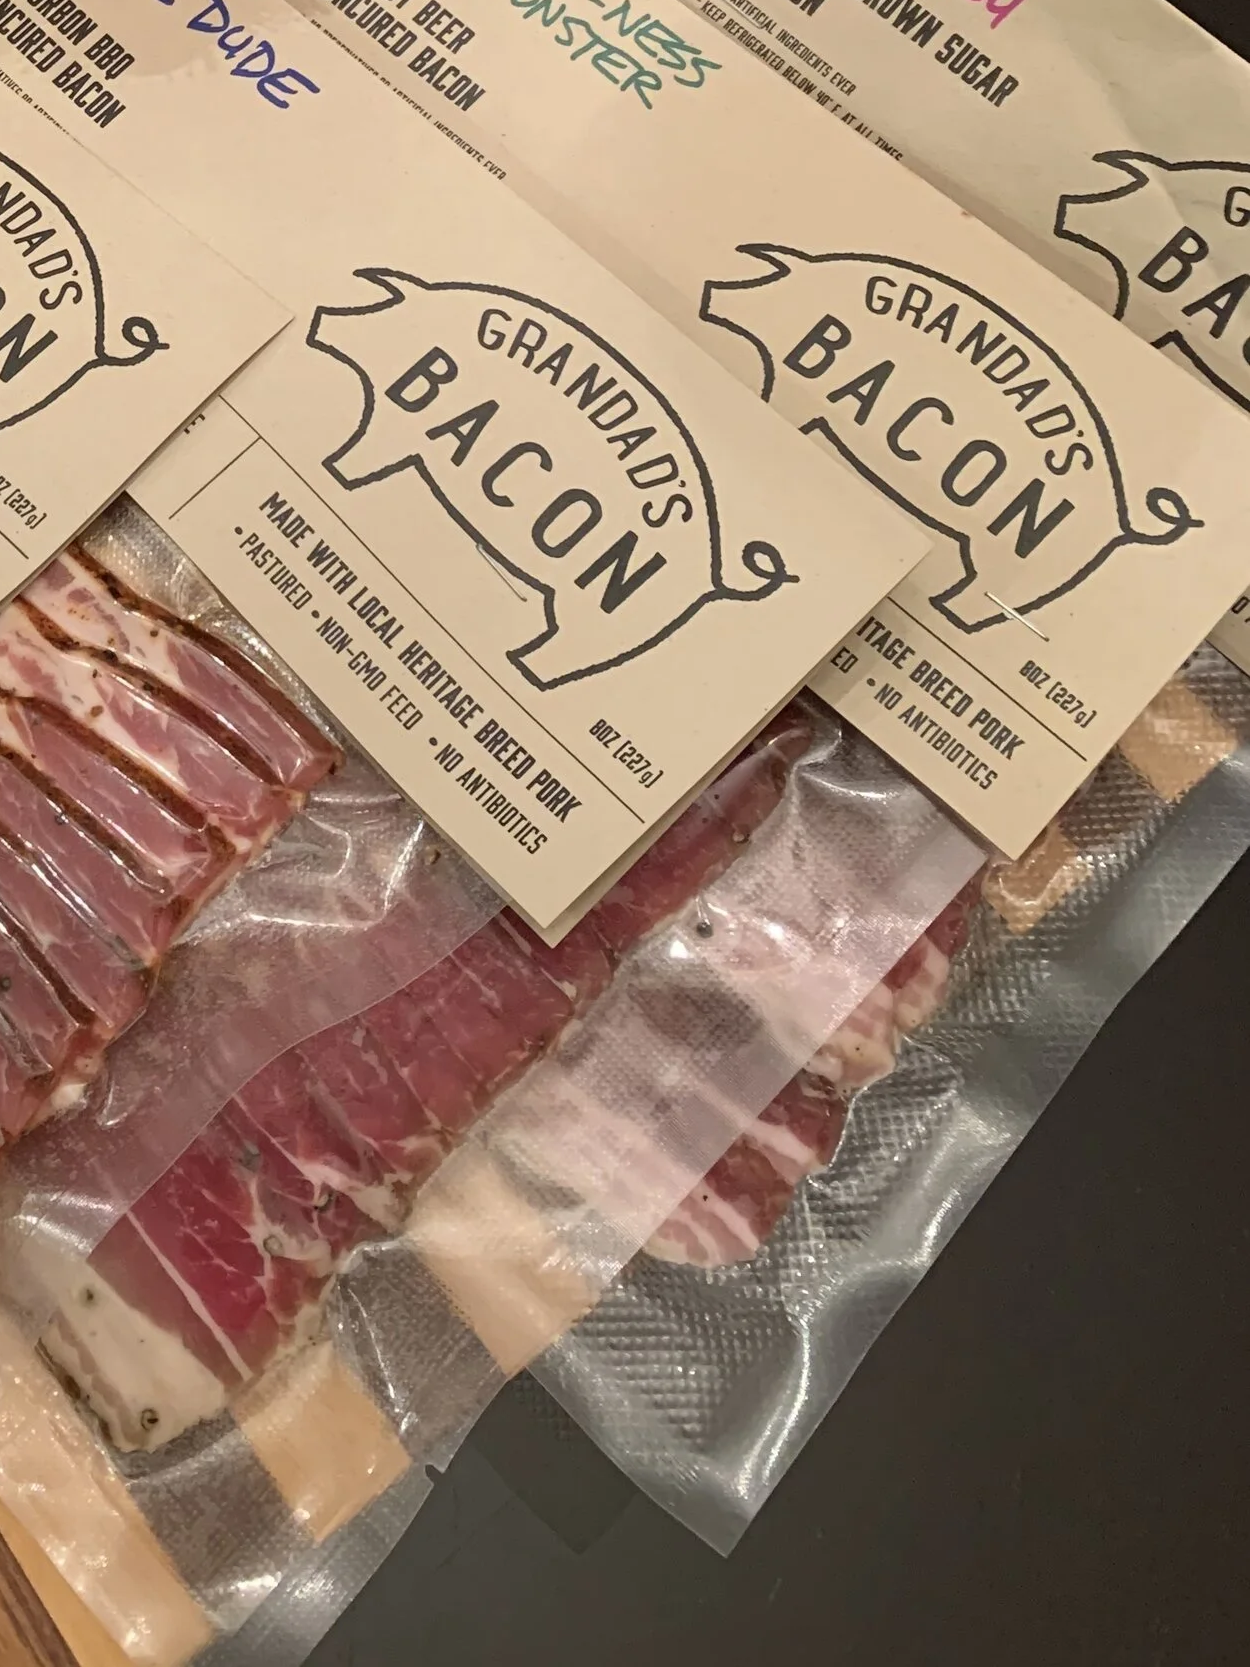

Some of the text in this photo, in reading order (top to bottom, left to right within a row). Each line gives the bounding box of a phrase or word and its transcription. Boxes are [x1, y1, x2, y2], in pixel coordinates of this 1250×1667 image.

[51, 60, 126, 128] BACON
[83, 32, 135, 79] BBQ
[406, 45, 486, 111] BACON
[699, 0, 726, 22] KEEP
[722, 17, 785, 71] REFRIGERATED
[781, 65, 817, 95] BELOW
[775, 28, 833, 77] INGREDIENTS
[829, 71, 856, 96] EVER
[934, 32, 1019, 107] SUGAR
[476, 309, 694, 530] GRANDAD'S
[781, 313, 1077, 561] BACON
[863, 274, 1095, 477] GRANDAD'S
[383, 345, 669, 615] BACON
[238, 532, 548, 854] PASTURED NON-GMO FEED NO ANTIBIOTICS
[258, 492, 582, 823] MADE WITH LOCAL HERITAGE BREED PORK
[830, 646, 998, 790] ED NO ANTIBIOTICS
[856, 615, 1024, 760] ITAGE BREED PORK
